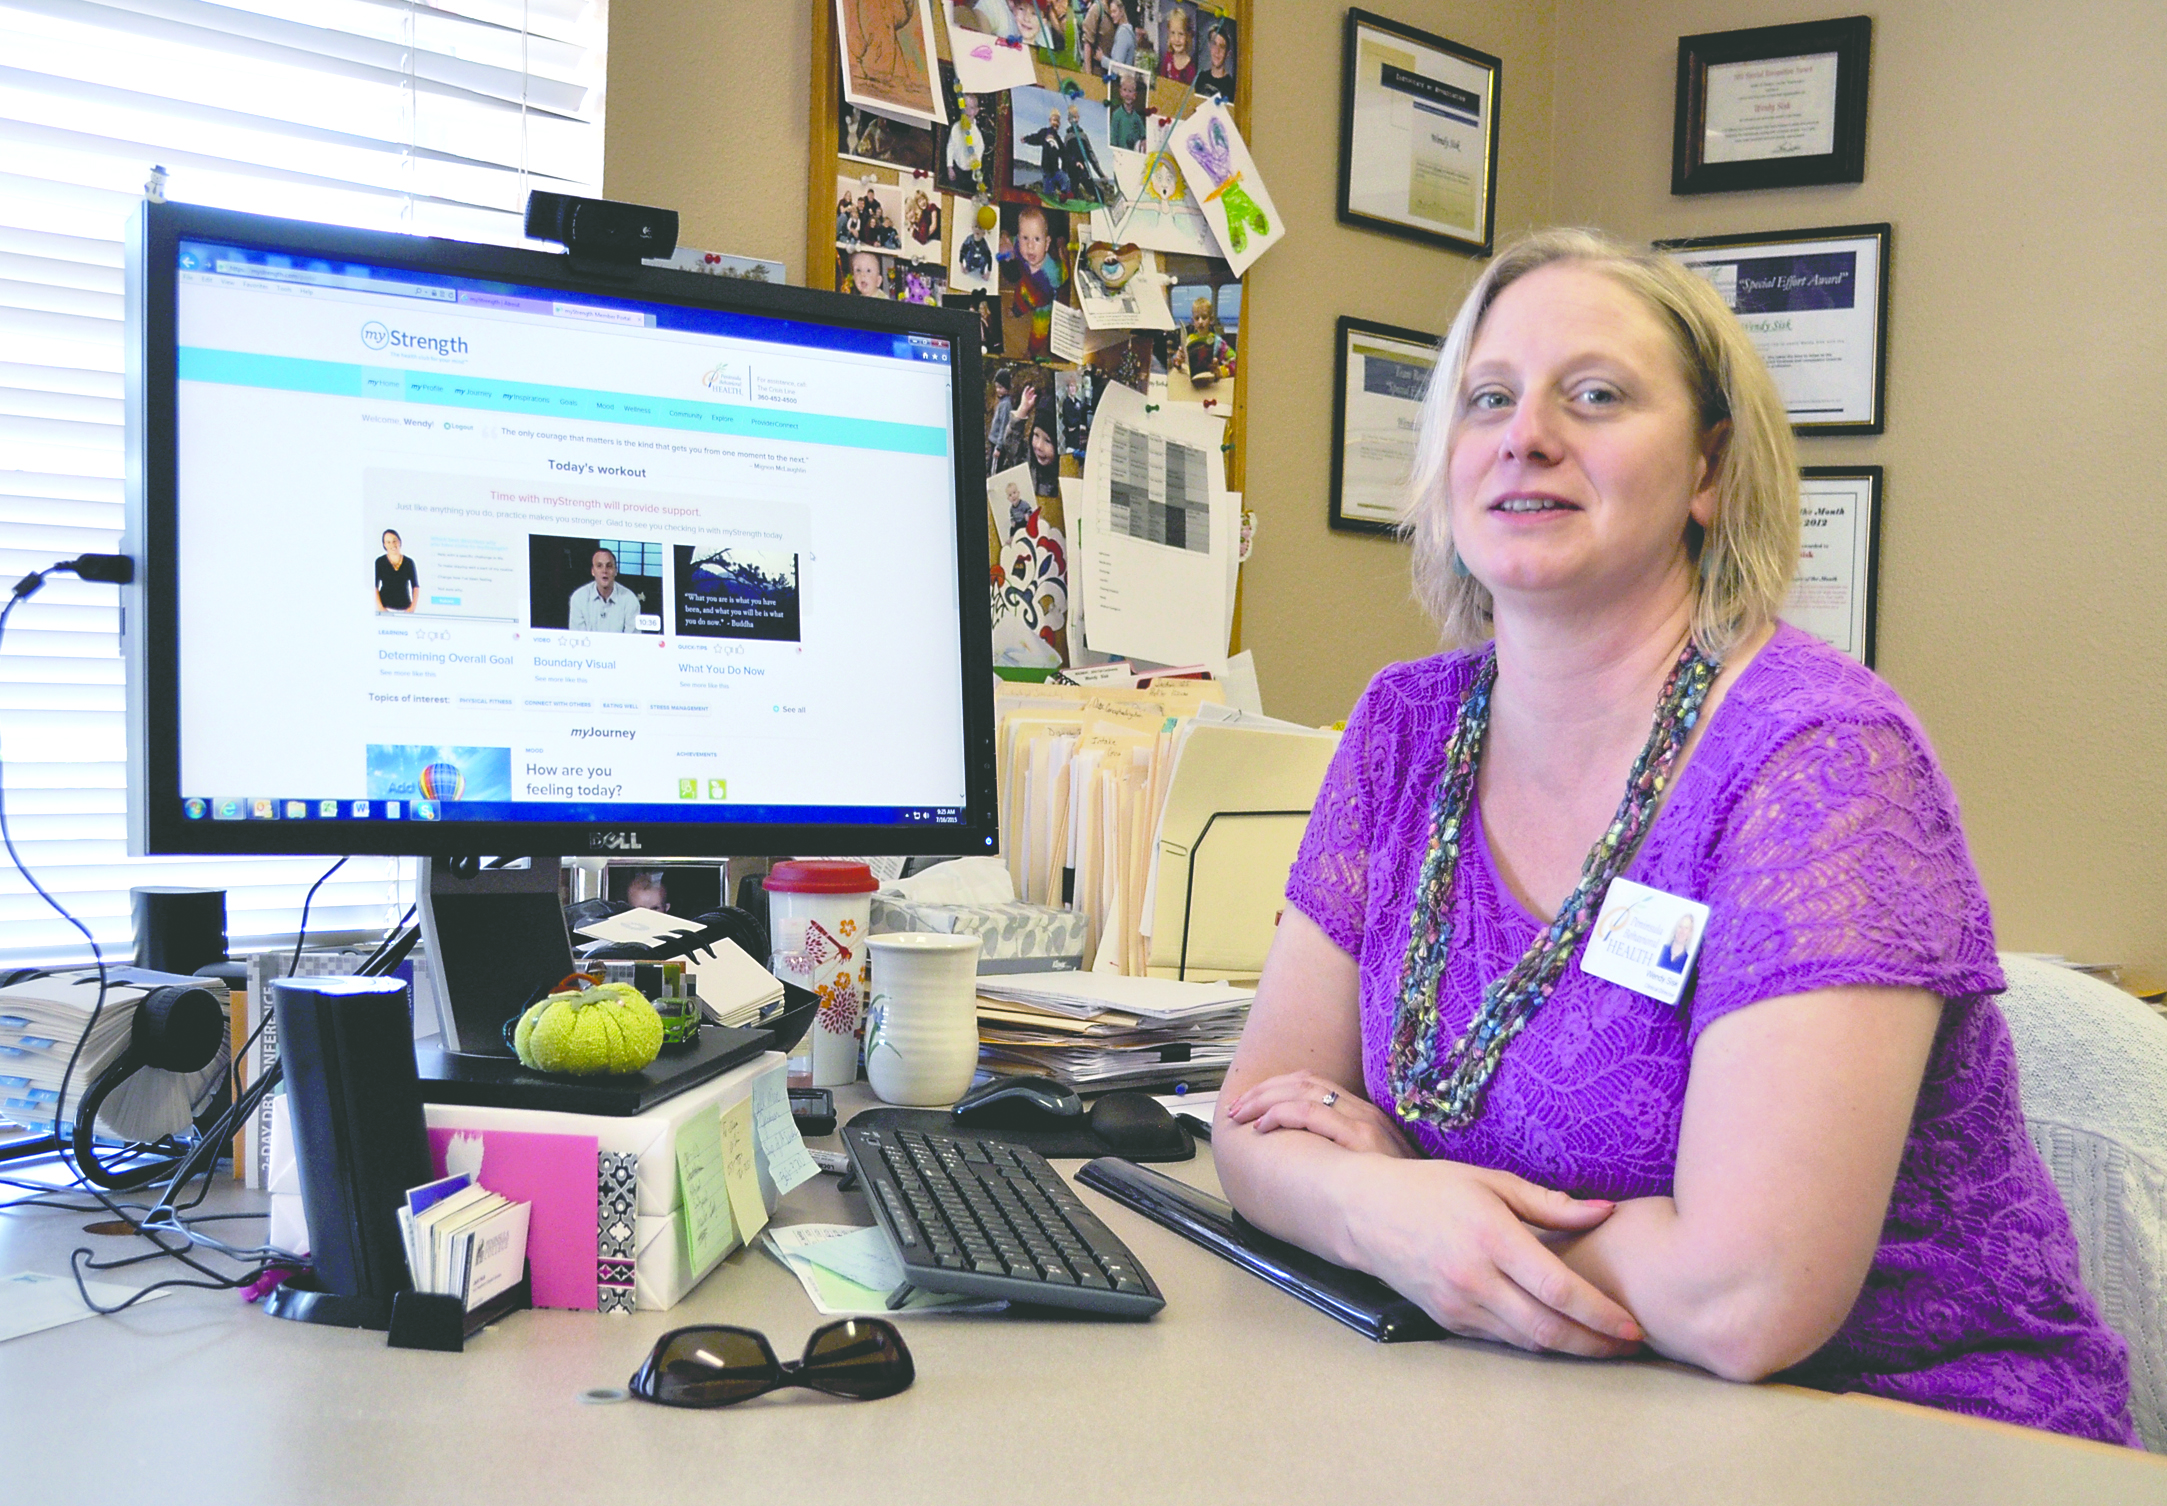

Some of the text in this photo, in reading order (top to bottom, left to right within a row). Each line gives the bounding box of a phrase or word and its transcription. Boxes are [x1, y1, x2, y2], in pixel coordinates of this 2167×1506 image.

[1777, 275, 1806, 291] Effort
[560, 399, 577, 407] Goals
[624, 405, 651, 414] Wellness
[669, 410, 702, 420] Community
[711, 415, 733, 423] Explore
[452, 423, 473, 431] Logout
[502, 428, 516, 436] The
[518, 429, 534, 439] only
[536, 432, 567, 441] courage
[569, 434, 584, 442] that
[587, 437, 614, 445] matters
[638, 441, 653, 449] kind
[672, 445, 687, 453] gets
[689, 447, 702, 455] you
[704, 447, 720, 455] from
[738, 452, 766, 460] moment
[548, 459, 646, 478] Today's workout
[490, 491, 701, 517] Time with myStrength will provide support.
[395, 503, 412, 511] Just
[414, 504, 428, 512] like
[430, 505, 463, 516] anything
[466, 509, 480, 517] you
[482, 509, 495, 518] do,
[496, 511, 527, 521] practice
[529, 513, 553, 521] makes
[556, 515, 570, 524] you
[606, 519, 623, 528] Glad
[650, 523, 662, 531] you
[664, 524, 696, 533] checking
[706, 526, 720, 535] with
[722, 528, 762, 539] myStrength
[1804, 519, 1827, 527] 2012
[685, 605, 701, 614] been,
[715, 607, 729, 615] what
[743, 608, 753, 616] will
[731, 620, 754, 628] Buddha
[379, 650, 513, 664] Determining Overall Goal
[534, 657, 616, 670] Boundary Visual
[679, 664, 765, 675] What You Do Now
[369, 693, 450, 704] Topics of interest:
[571, 727, 636, 741] myJourney
[527, 764, 612, 779] How are you
[389, 782, 415, 794] Add
[527, 784, 622, 798] feeling today?
[589, 832, 642, 849] DELL
[1607, 939, 1654, 966] HEALTH
[1646, 970, 1665, 982] Wendy
